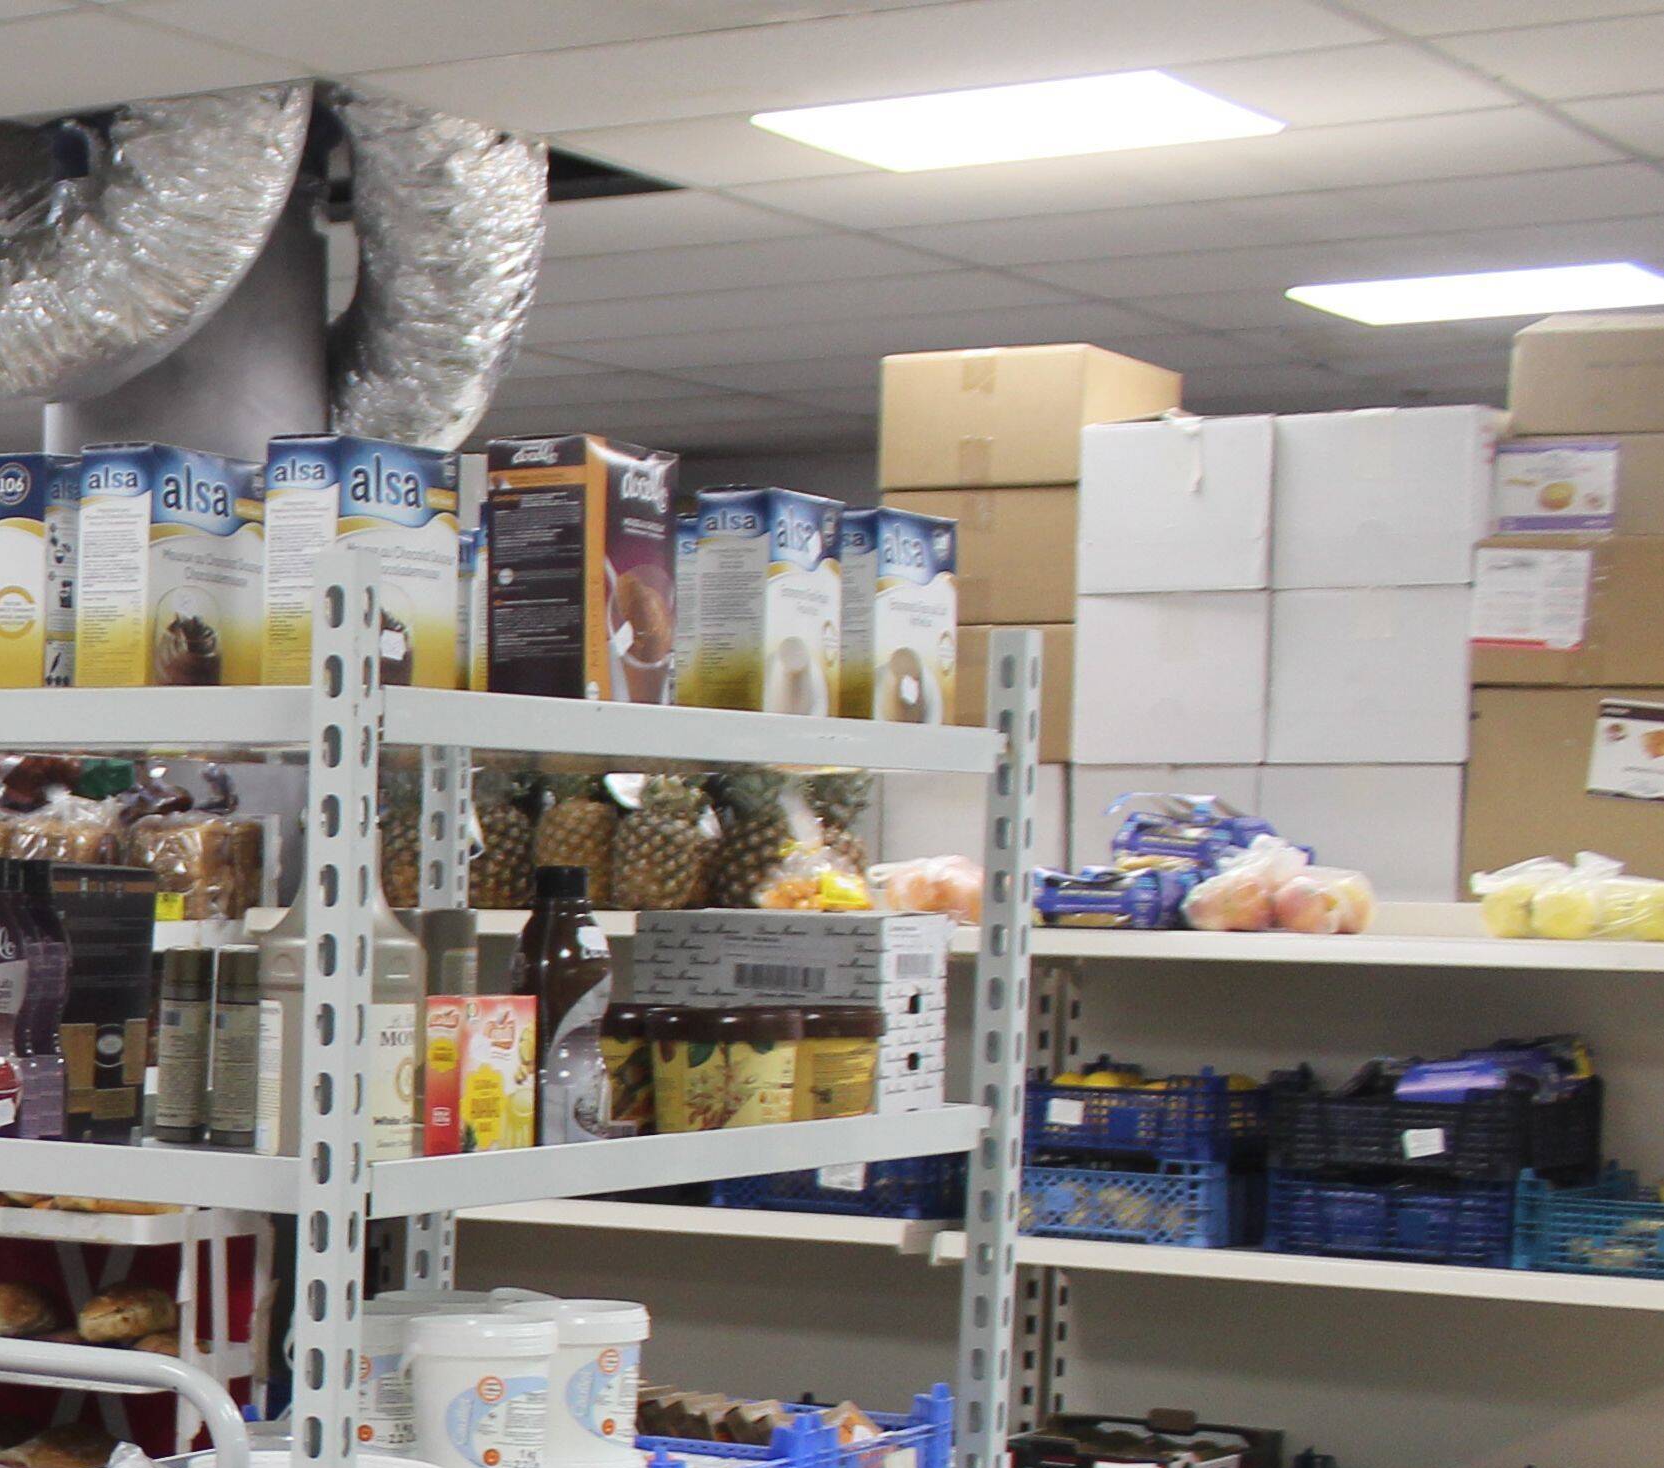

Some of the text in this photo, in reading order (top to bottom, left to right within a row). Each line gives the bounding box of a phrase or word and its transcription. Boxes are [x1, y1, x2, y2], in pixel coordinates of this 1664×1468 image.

[88, 465, 138, 489] alsa
[275, 457, 326, 482] alsa
[351, 453, 422, 509] alsa
[163, 462, 230, 518] alsa
[705, 510, 759, 531] alsa
